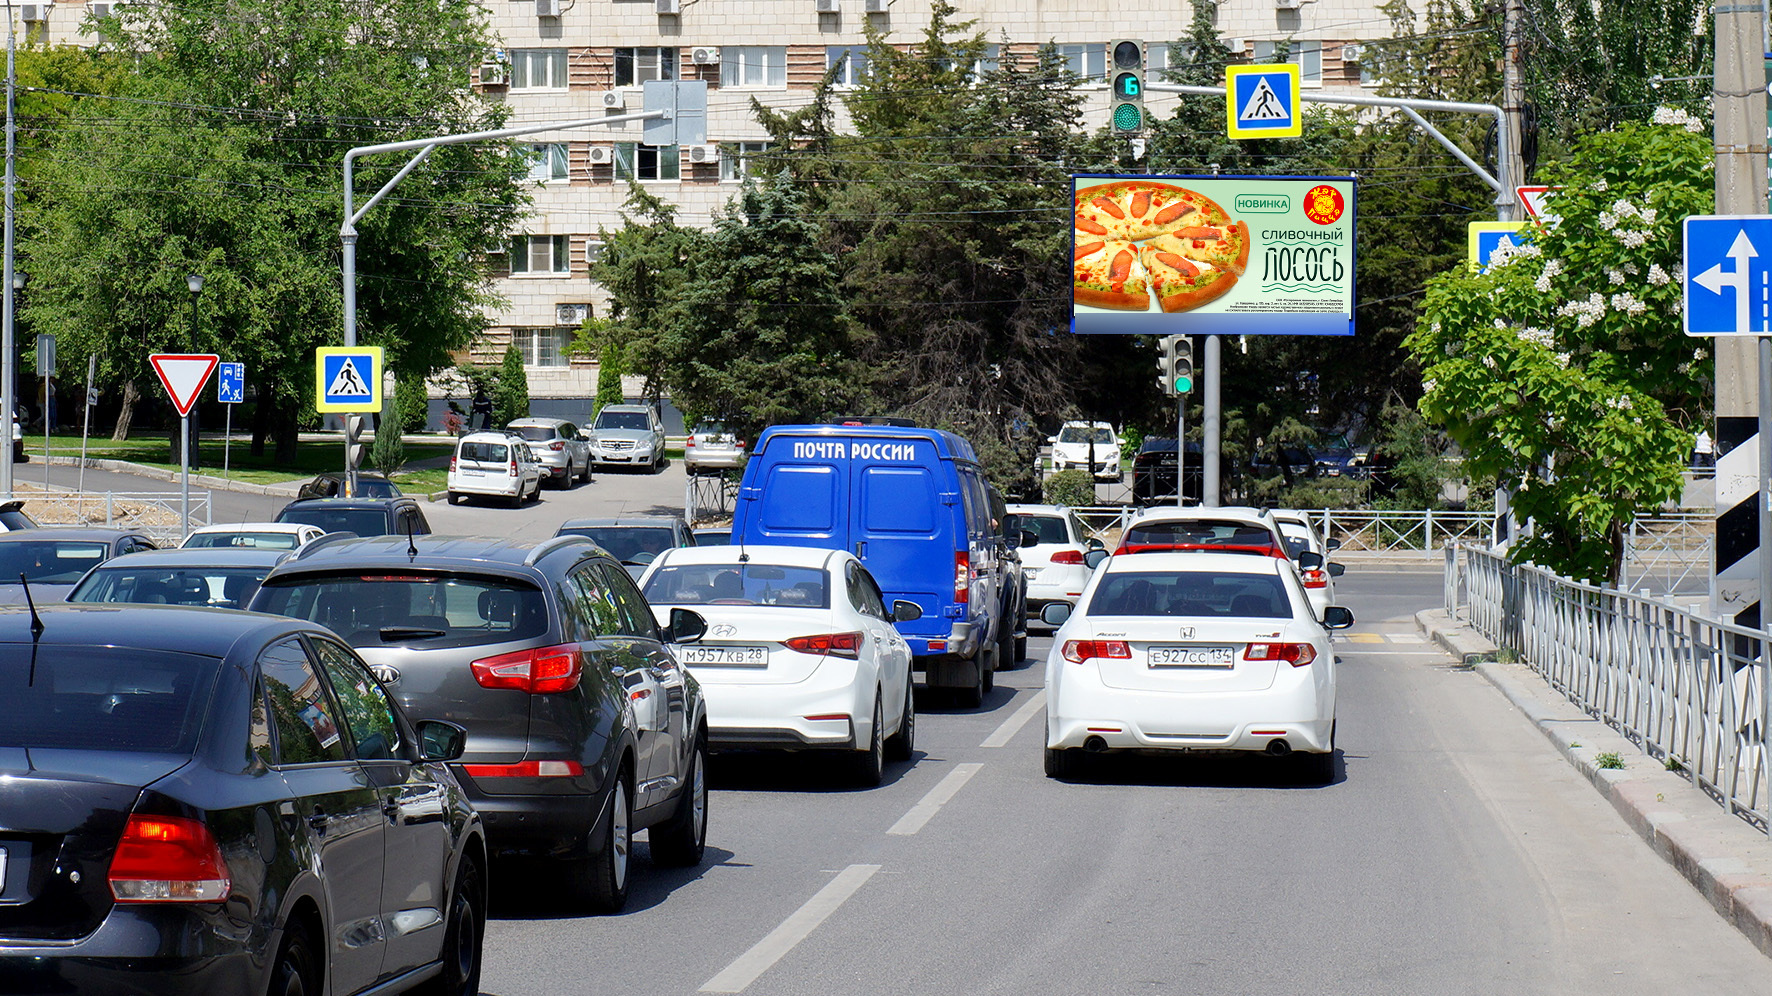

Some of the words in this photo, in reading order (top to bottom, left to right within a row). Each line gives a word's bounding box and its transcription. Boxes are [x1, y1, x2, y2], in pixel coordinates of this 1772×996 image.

[1238, 199, 1288, 209] НОВИНКА
[1261, 227, 1344, 240] СЛИВОЧНЫЙ
[1262, 247, 1344, 282] ЛОСОСЬ
[793, 442, 846, 459] ПОЧТА
[851, 443, 915, 461] РОССИИ
[372, 669, 394, 682] IA
